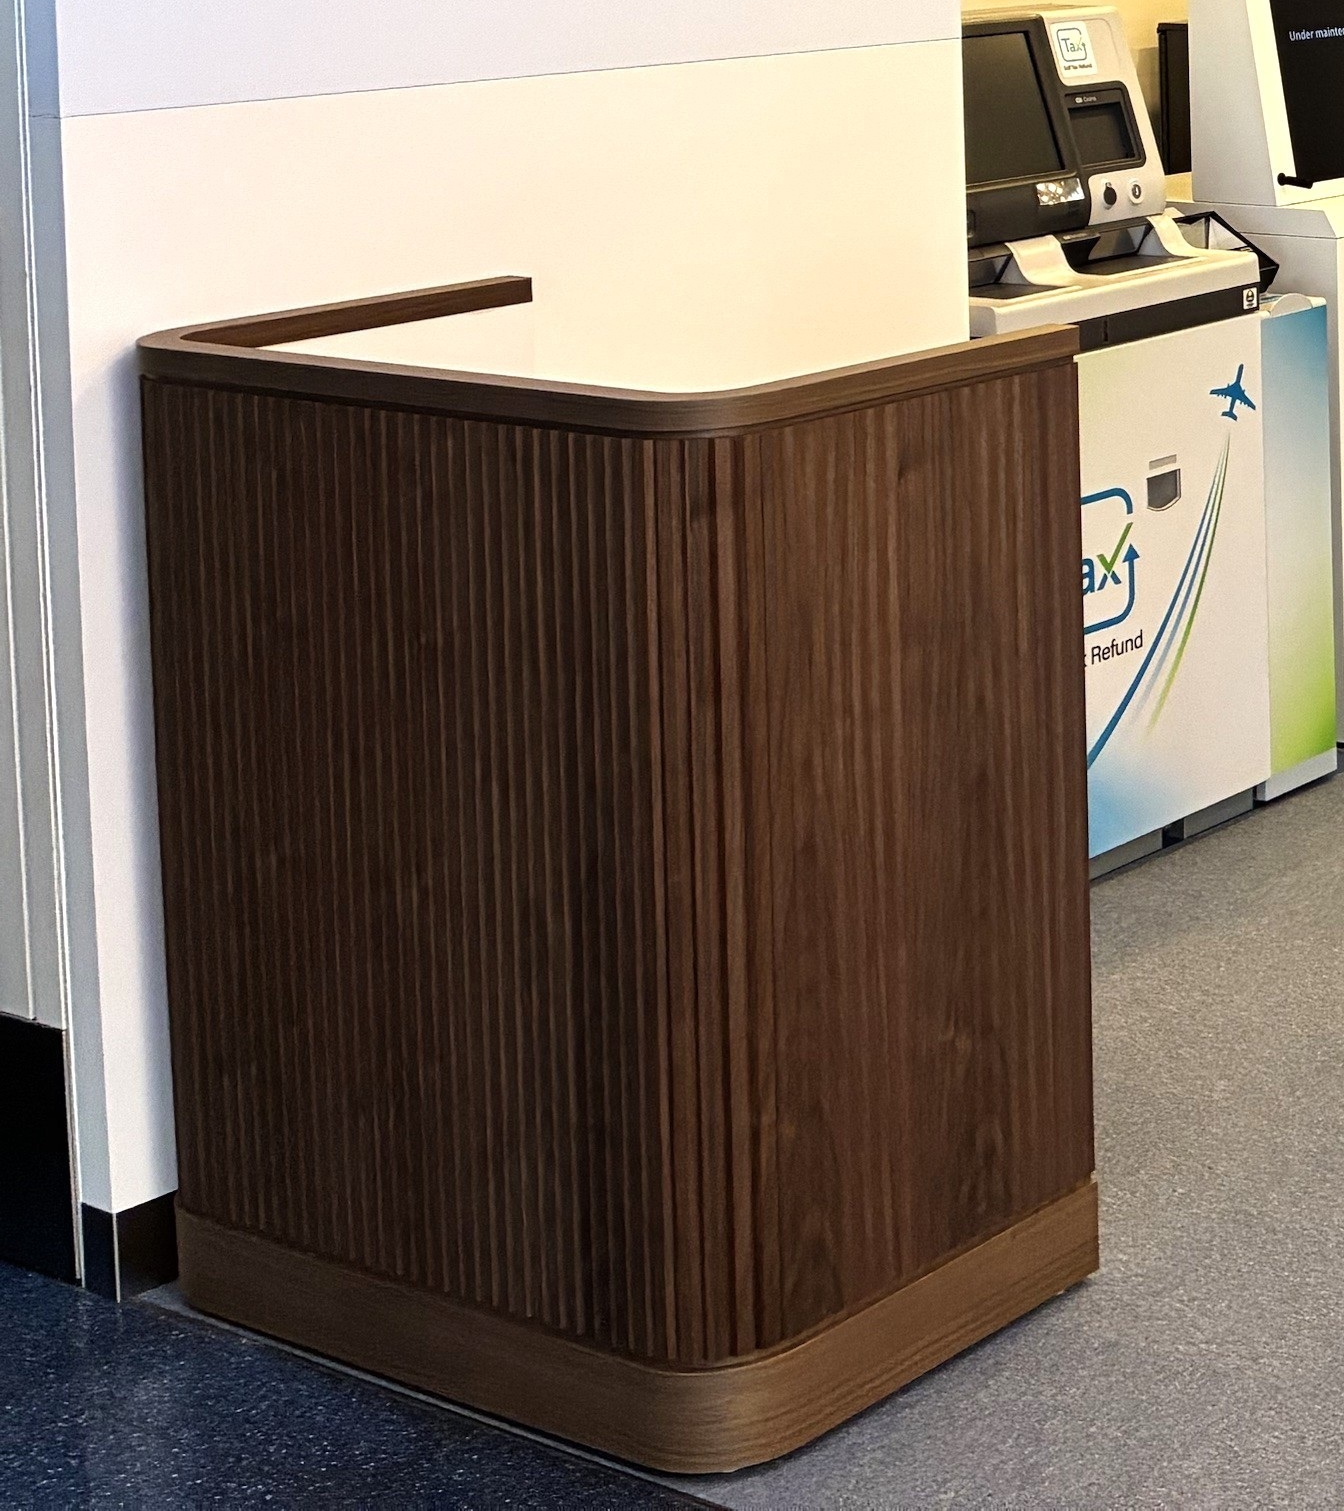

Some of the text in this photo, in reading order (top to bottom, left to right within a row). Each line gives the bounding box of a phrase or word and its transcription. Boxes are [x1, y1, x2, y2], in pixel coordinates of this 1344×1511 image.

[1060, 37, 1083, 53] Tax
[1289, 29, 1314, 41] Under
[1081, 521, 1134, 596] ax
[1091, 629, 1144, 666] Refund
